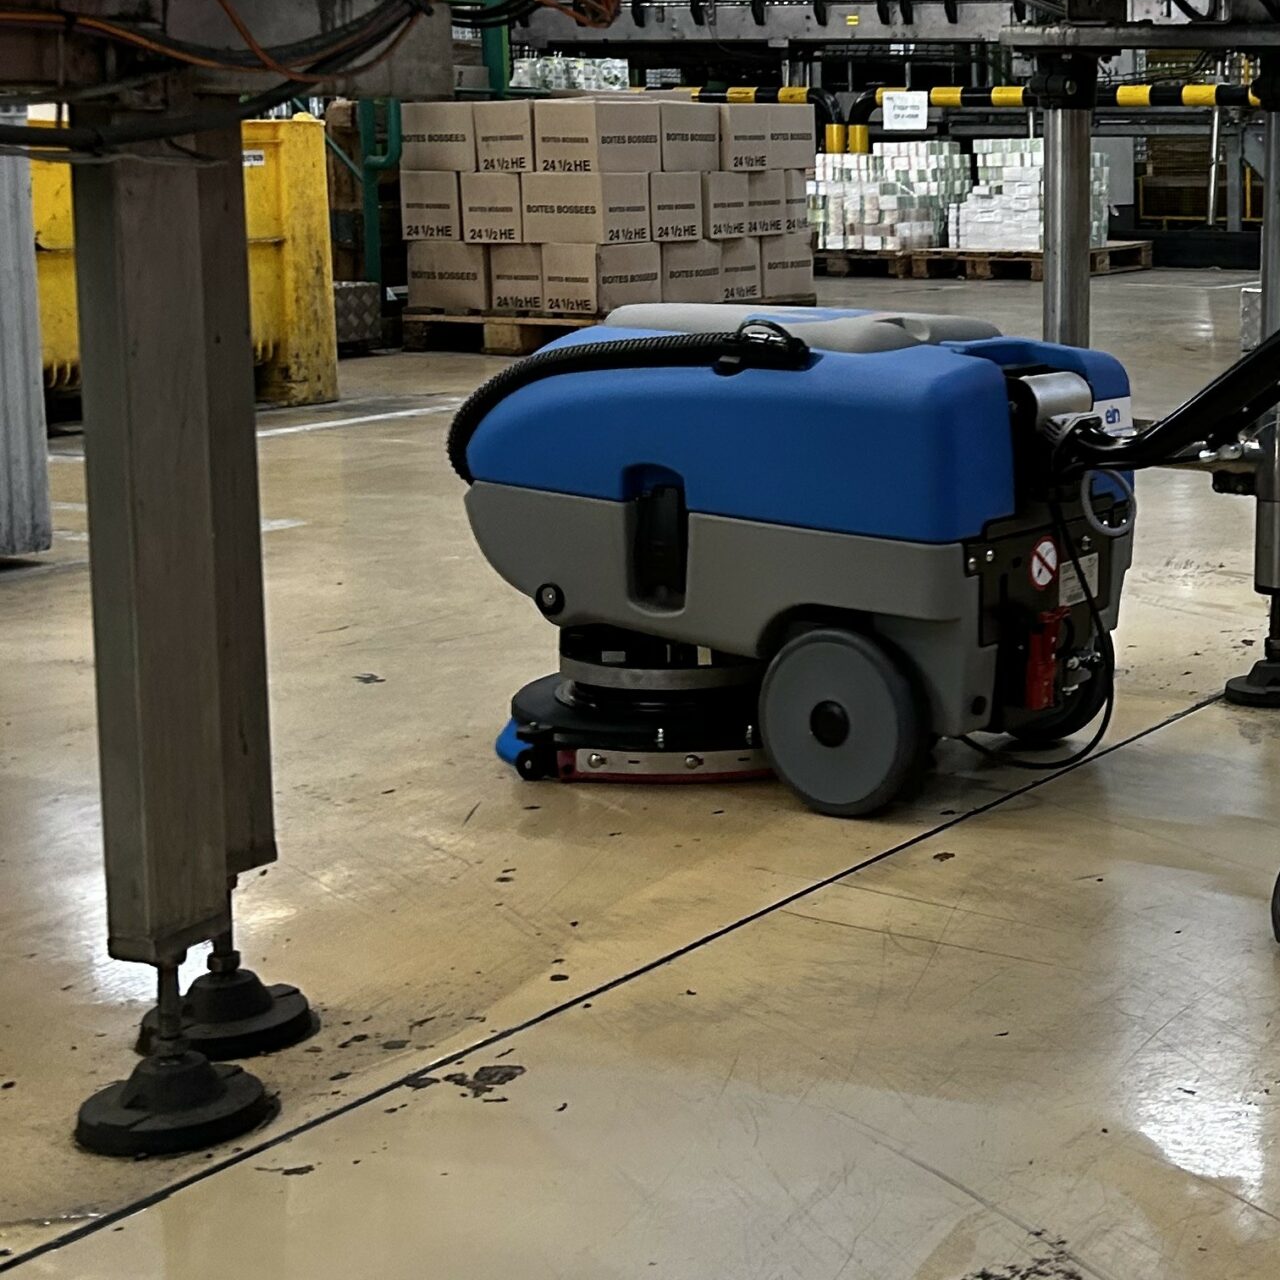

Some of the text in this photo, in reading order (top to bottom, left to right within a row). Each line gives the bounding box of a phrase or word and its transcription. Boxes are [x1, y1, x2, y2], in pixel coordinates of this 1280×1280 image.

[602, 136, 626, 144] BOITES
[484, 159, 495, 170] 24
[543, 160, 556, 171] 24
[734, 156, 743, 167] 24
[527, 205, 596, 214] BOITES BOSSEES
[713, 224, 722, 234] 24
[786, 219, 796, 230] 24
[406, 225, 419, 236] 24
[470, 228, 482, 240] 24
[609, 229, 620, 240] 24
[658, 226, 668, 237] 24
[602, 275, 628, 284] BOITES
[497, 296, 509, 308] 24
[548, 298, 560, 309] 24
